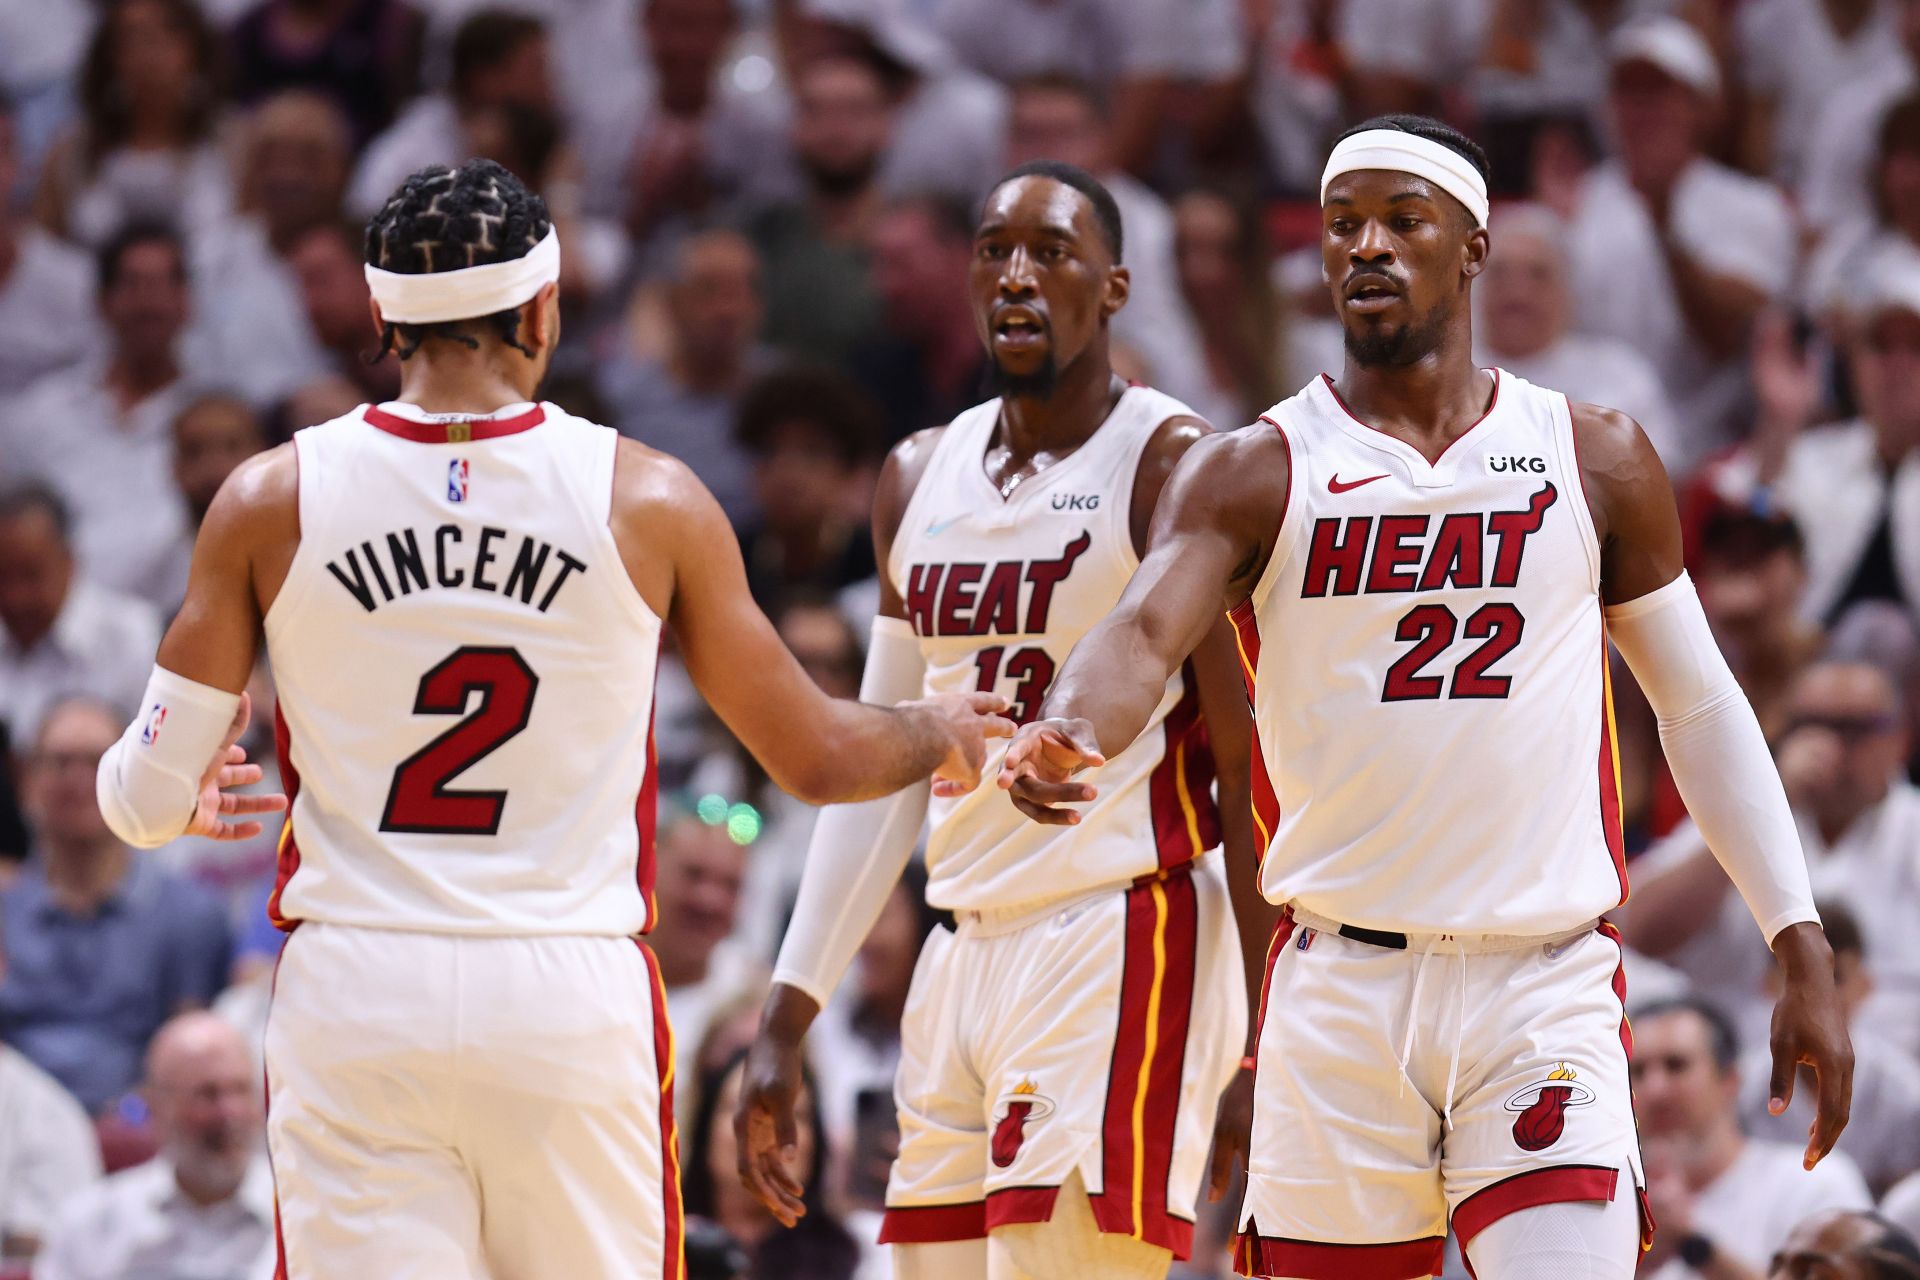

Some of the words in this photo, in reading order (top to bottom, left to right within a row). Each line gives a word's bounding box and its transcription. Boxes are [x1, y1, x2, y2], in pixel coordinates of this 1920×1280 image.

[326, 524, 587, 613] VINCENT
[907, 528, 1092, 637] HEAT
[1300, 480, 1558, 598] HEAT
[974, 645, 1056, 728] 13
[1381, 602, 1526, 702] 22
[378, 645, 539, 835] 2
